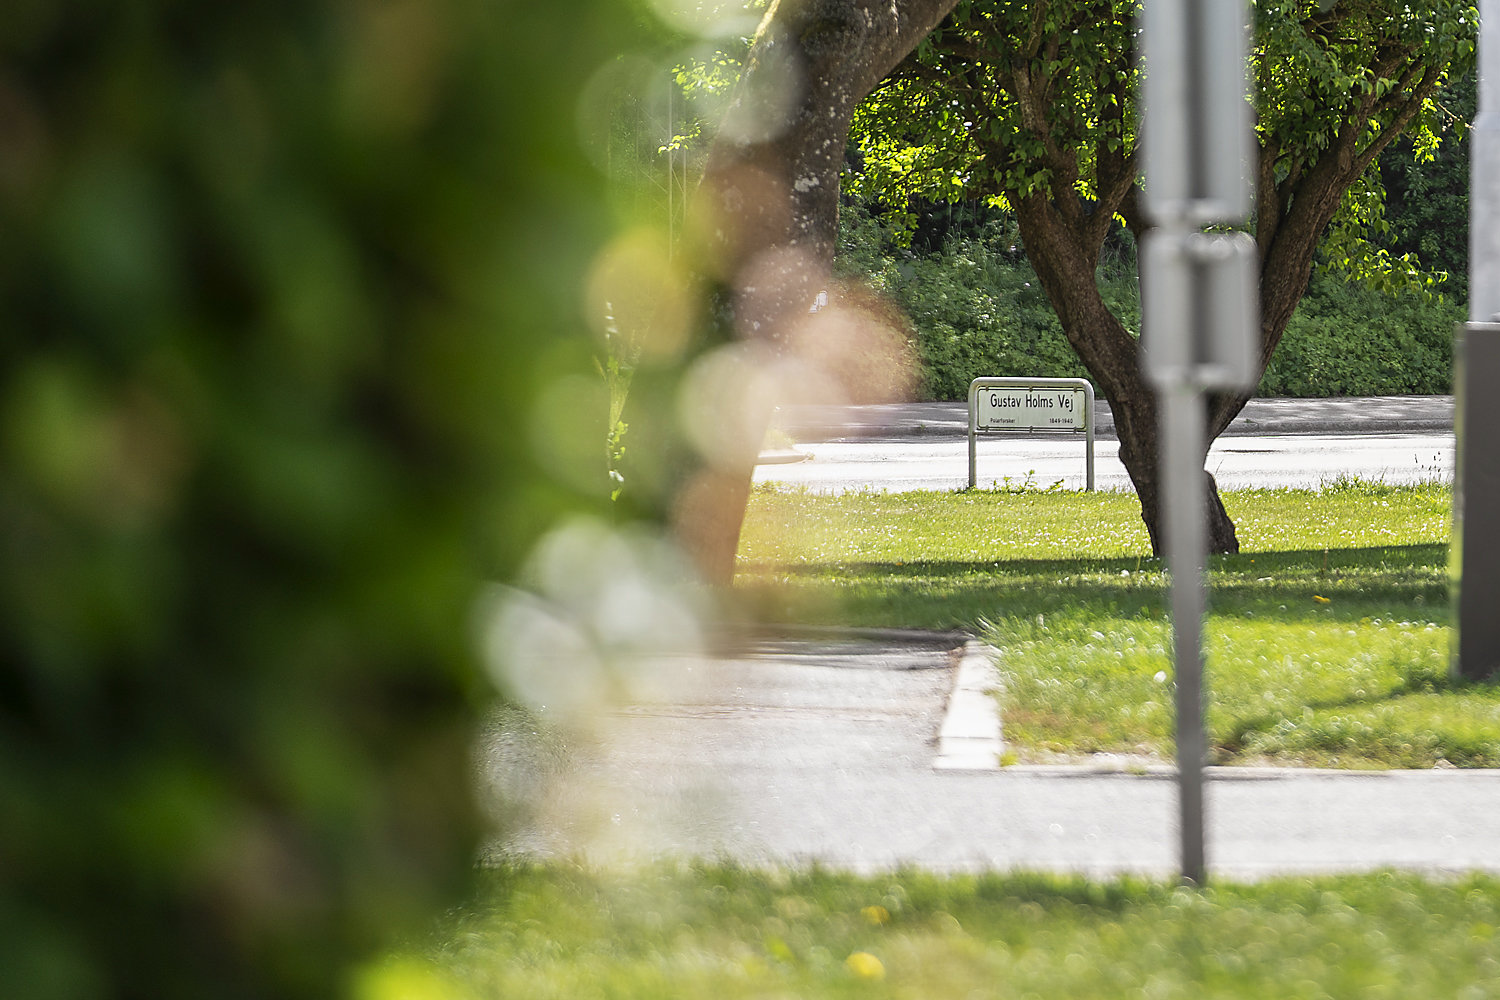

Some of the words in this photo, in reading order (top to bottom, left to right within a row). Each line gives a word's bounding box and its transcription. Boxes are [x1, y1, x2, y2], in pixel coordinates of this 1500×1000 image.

[990, 393, 1021, 408] Gustav
[1025, 394, 1053, 408] Holms
[1057, 394, 1073, 412] Vej
